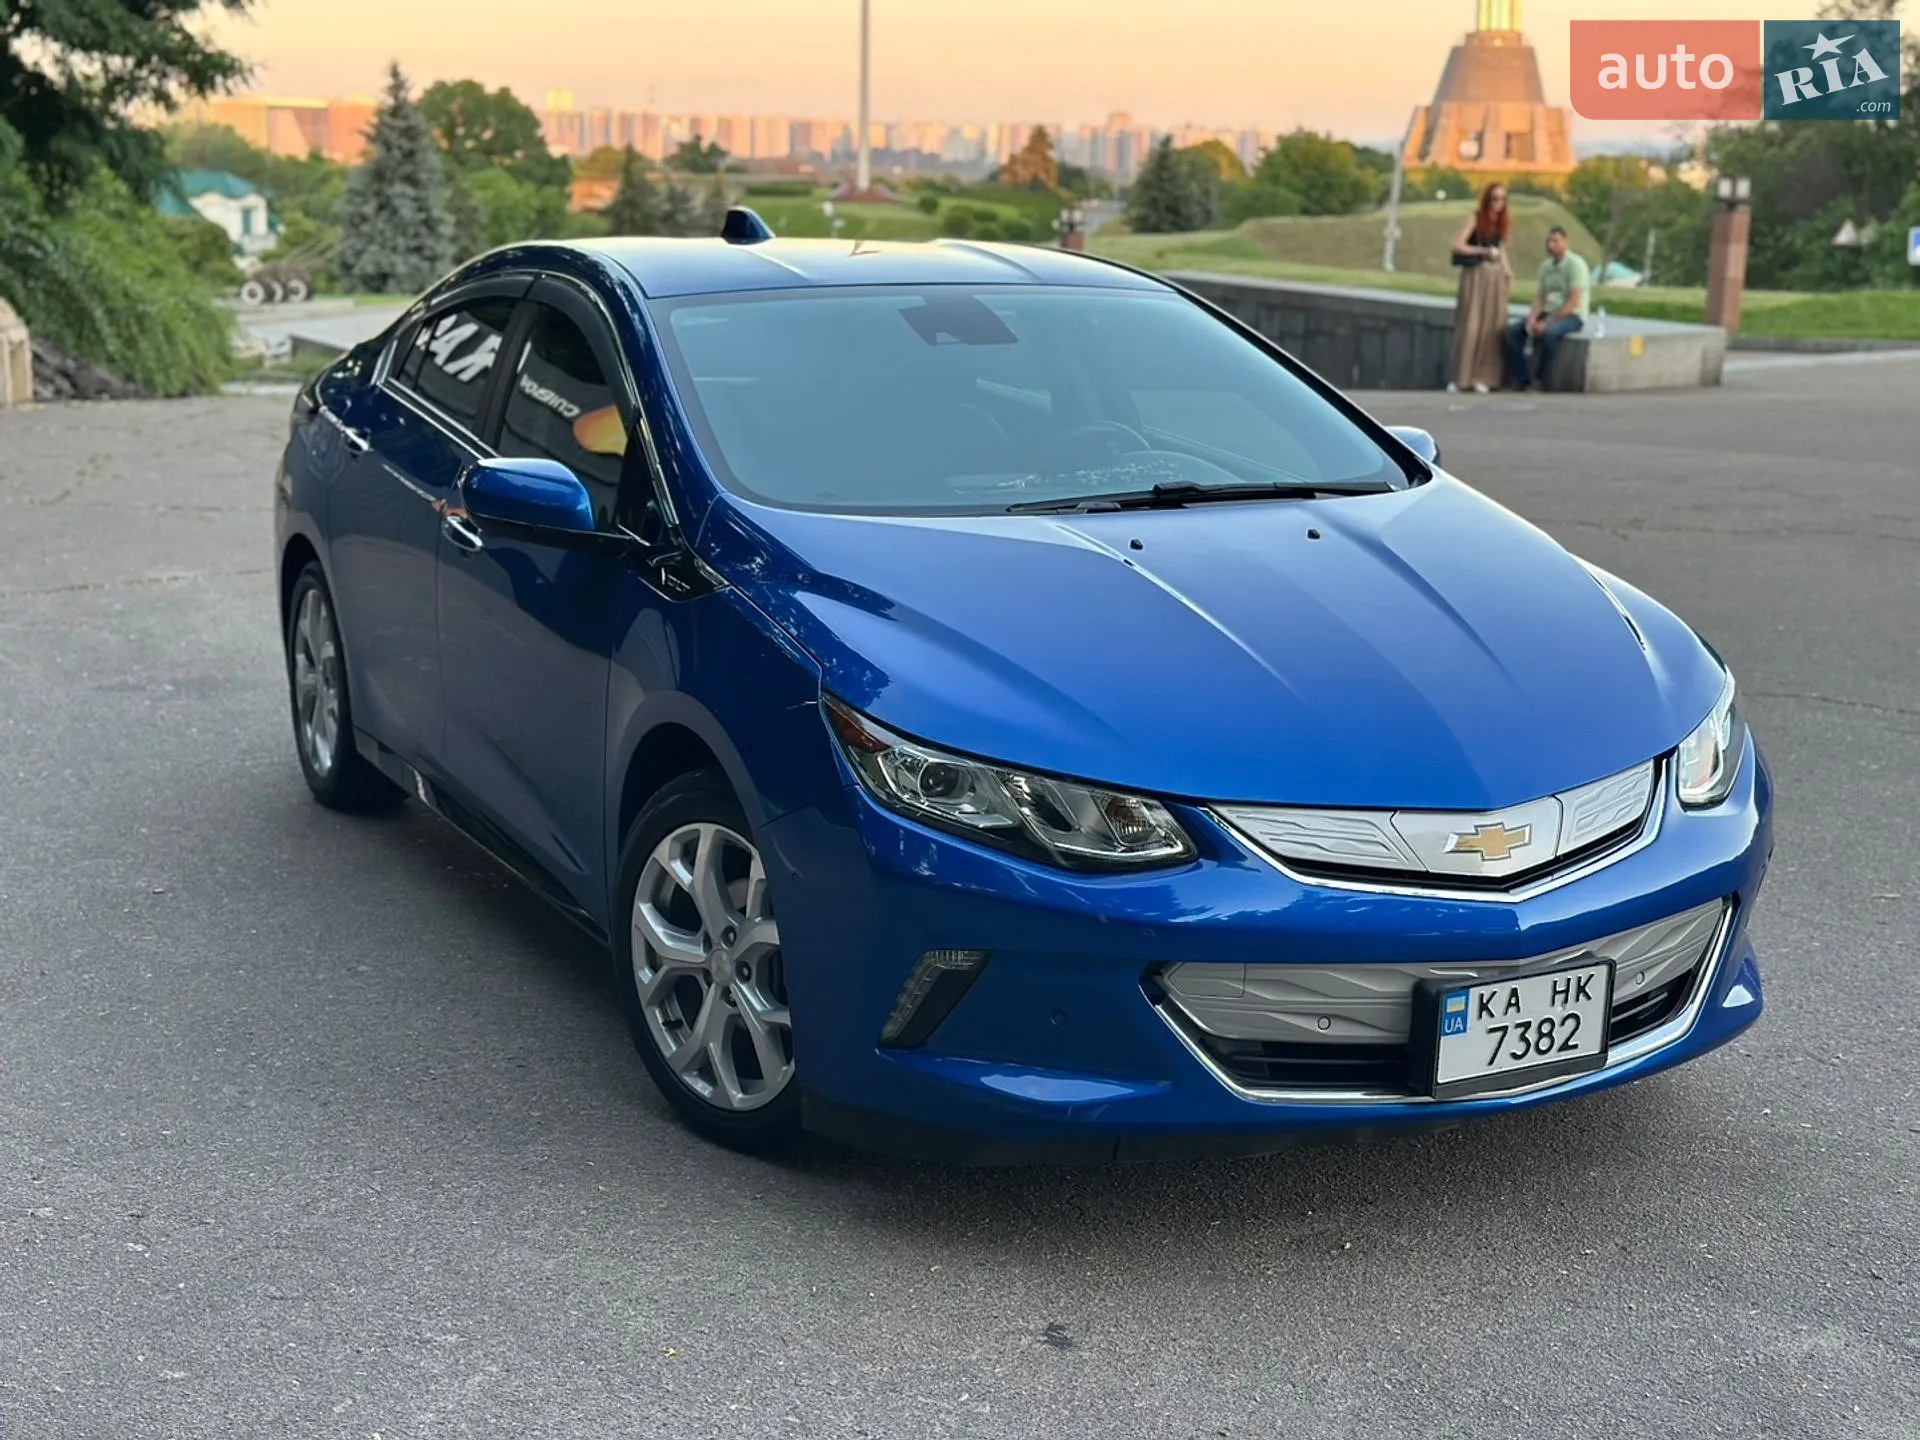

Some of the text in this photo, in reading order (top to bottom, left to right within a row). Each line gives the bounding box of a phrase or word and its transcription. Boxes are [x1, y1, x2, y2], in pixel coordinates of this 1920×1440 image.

[1477, 973, 1595, 1020] KA HK
[1443, 1016, 1464, 1033] UA
[1486, 1012, 1581, 1067] 7382
